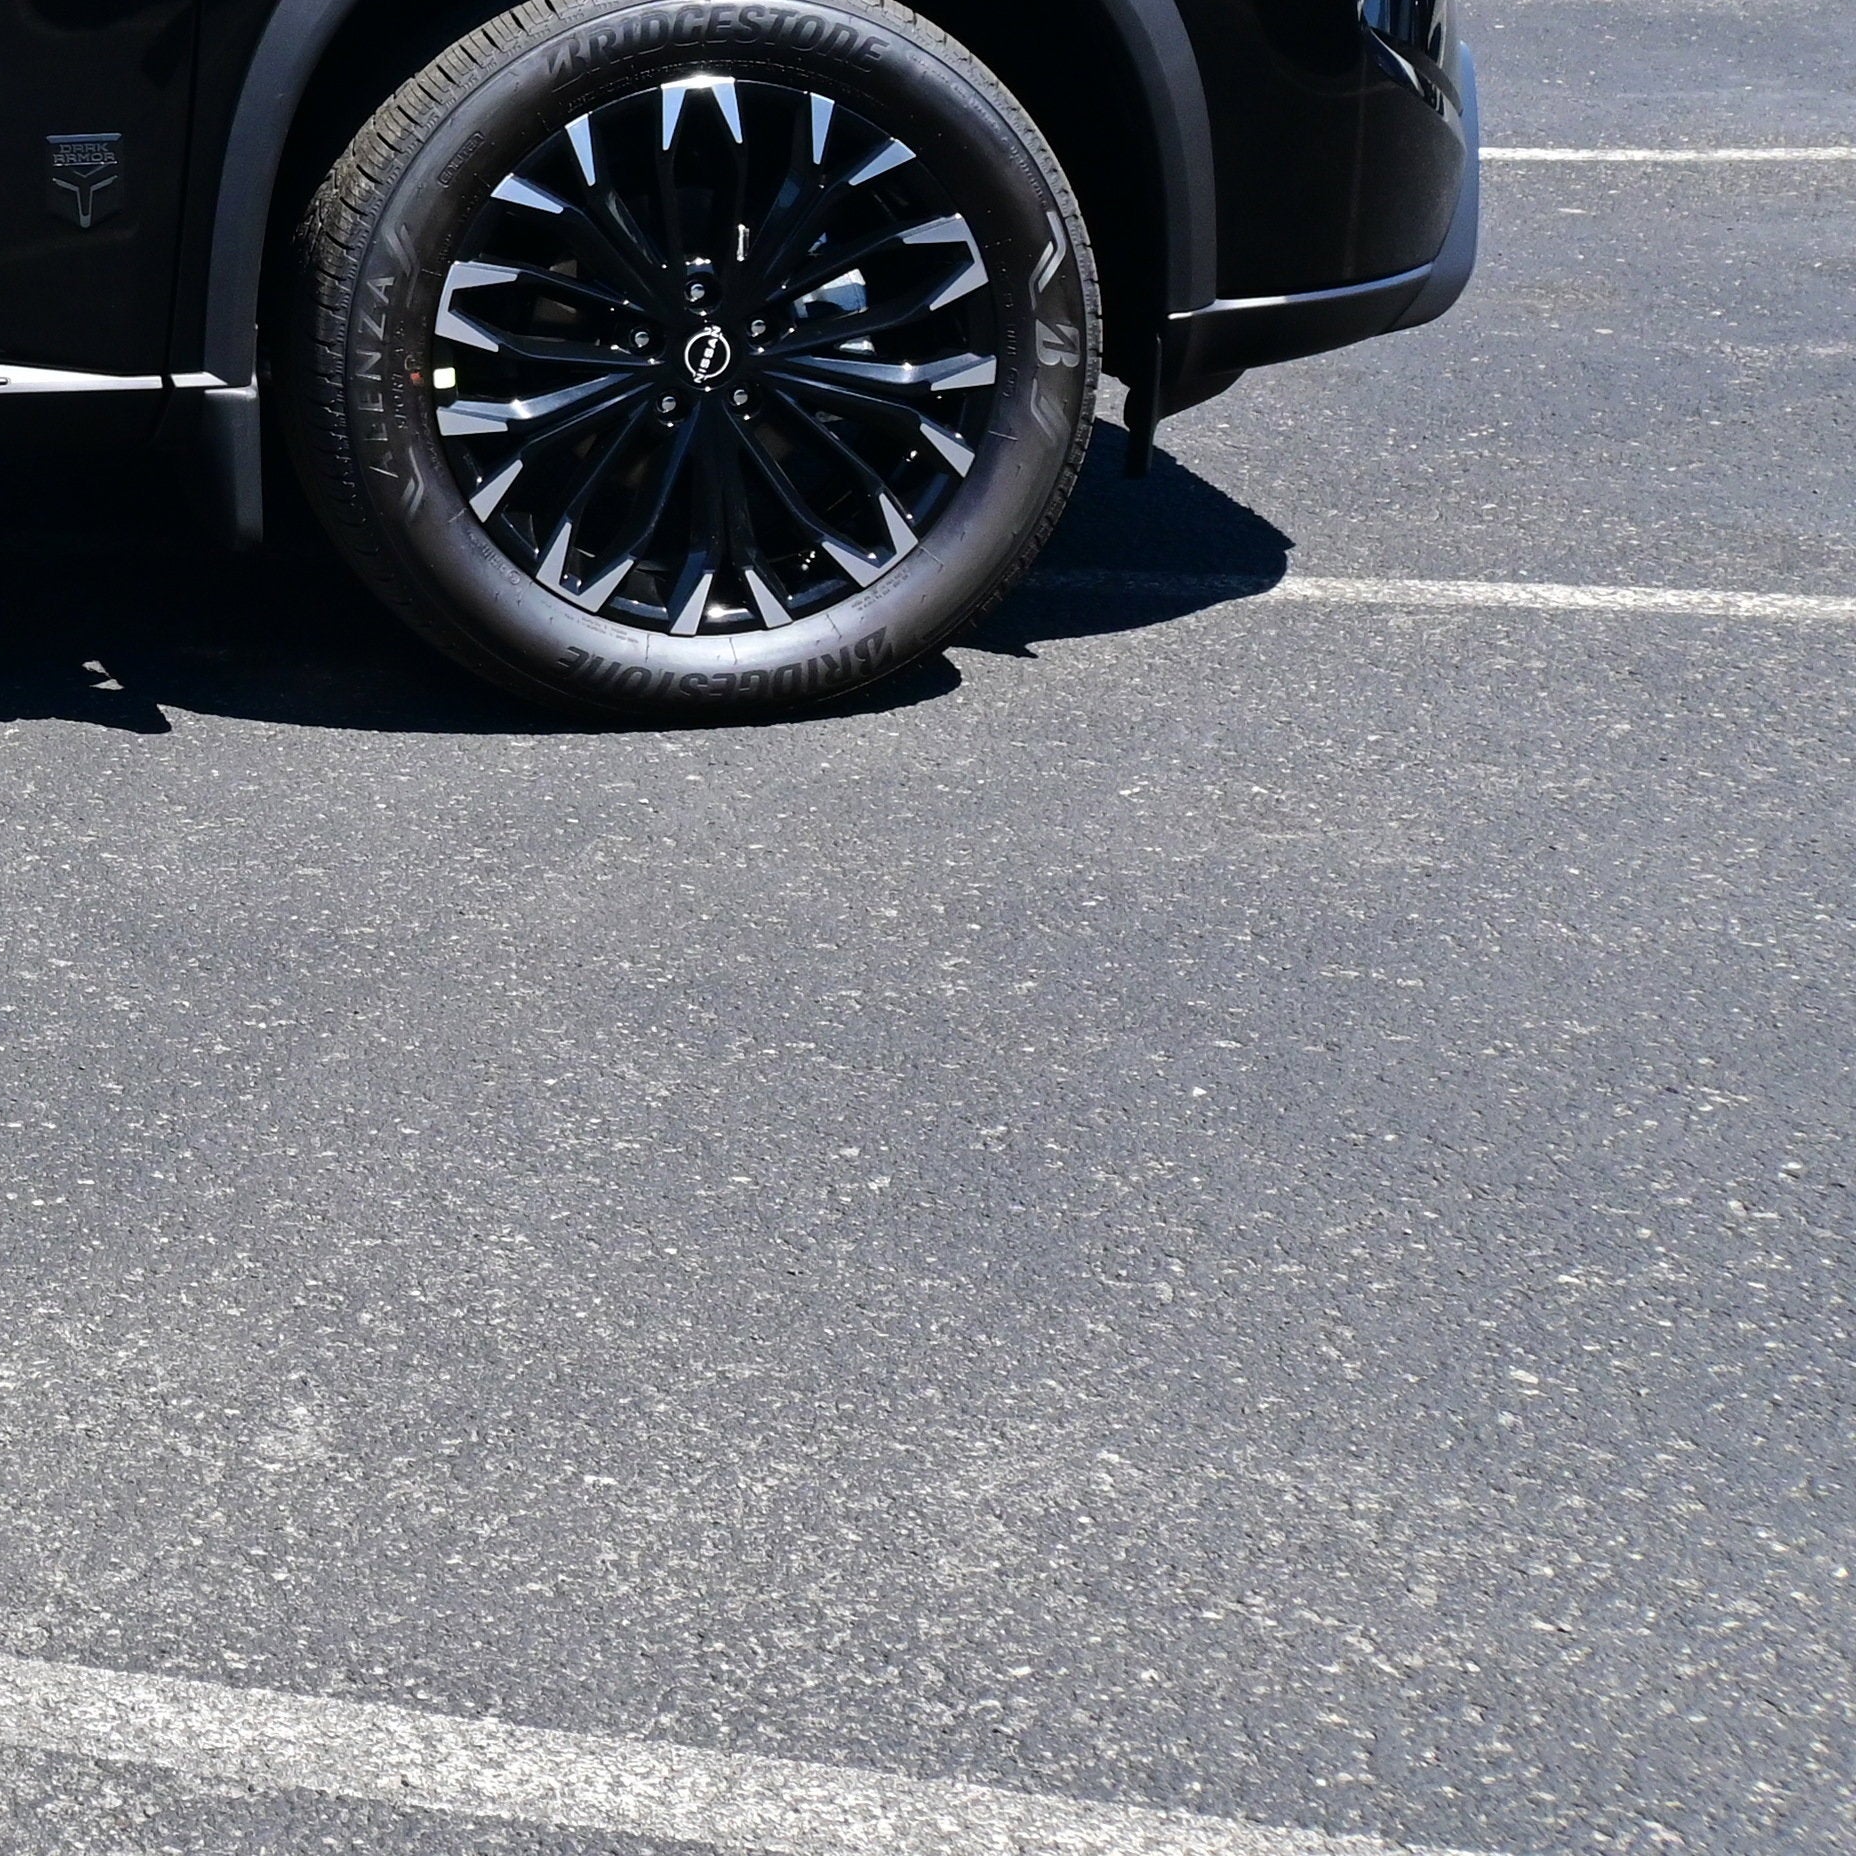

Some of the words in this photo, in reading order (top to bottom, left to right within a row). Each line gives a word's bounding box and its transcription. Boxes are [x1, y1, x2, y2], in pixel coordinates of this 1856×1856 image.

[549, 4, 890, 82] BRIDGESTONE
[693, 325, 722, 384] NISSAN
[558, 626, 895, 705] BRIDGESTONE
